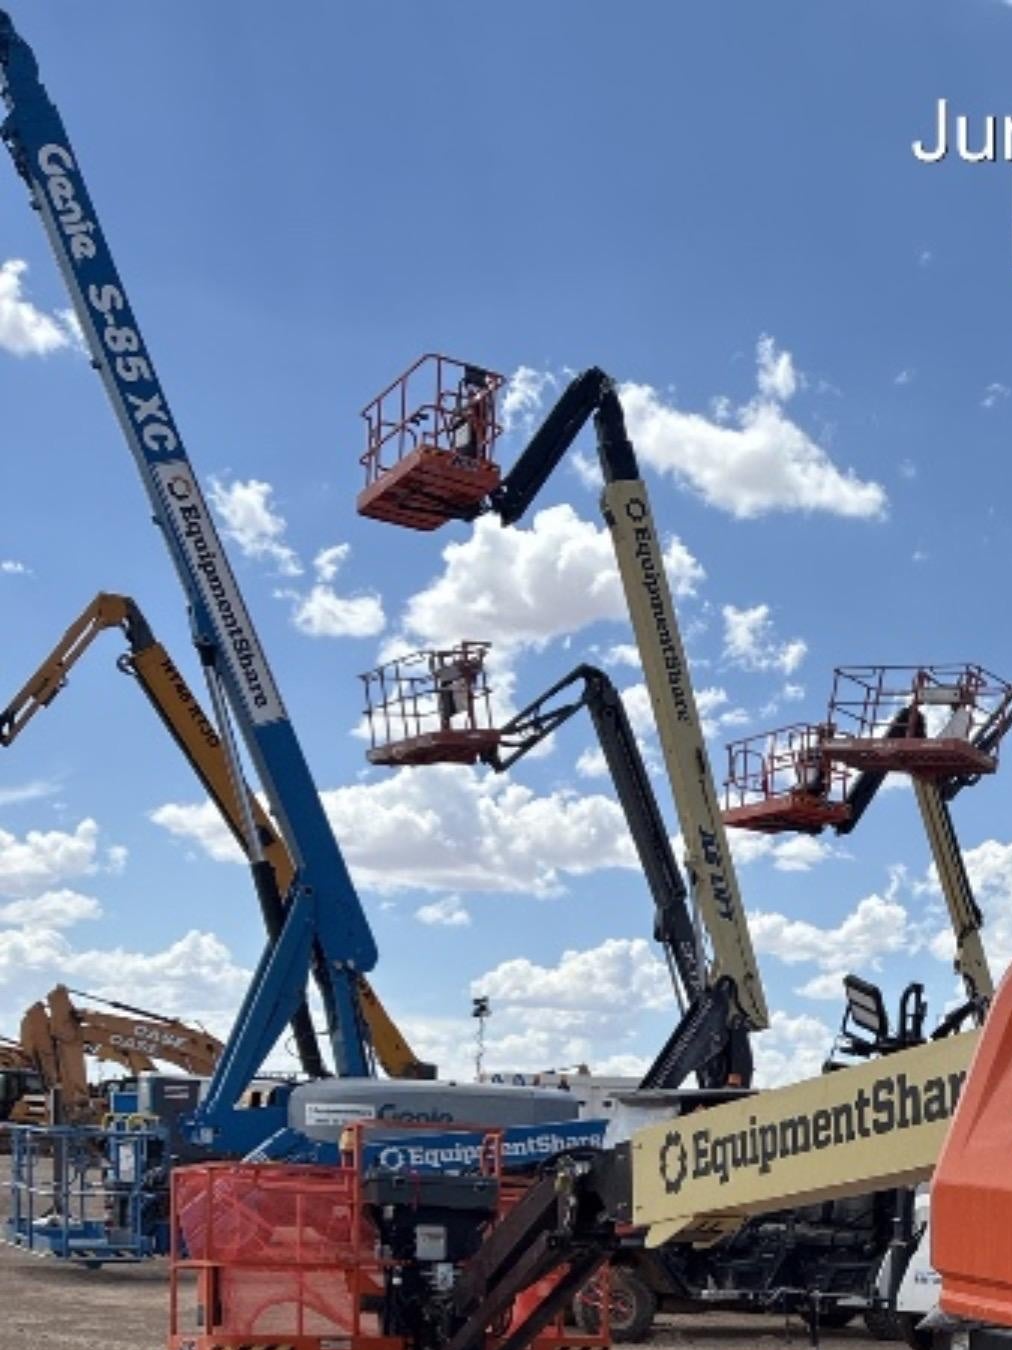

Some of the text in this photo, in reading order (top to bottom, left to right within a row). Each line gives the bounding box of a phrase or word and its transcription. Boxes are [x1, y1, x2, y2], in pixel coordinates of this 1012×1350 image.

[38, 143, 177, 451] Genie S-85 XC
[179, 502, 268, 709] EquipmentShare
[692, 1070, 968, 1186] EquipmentShar
